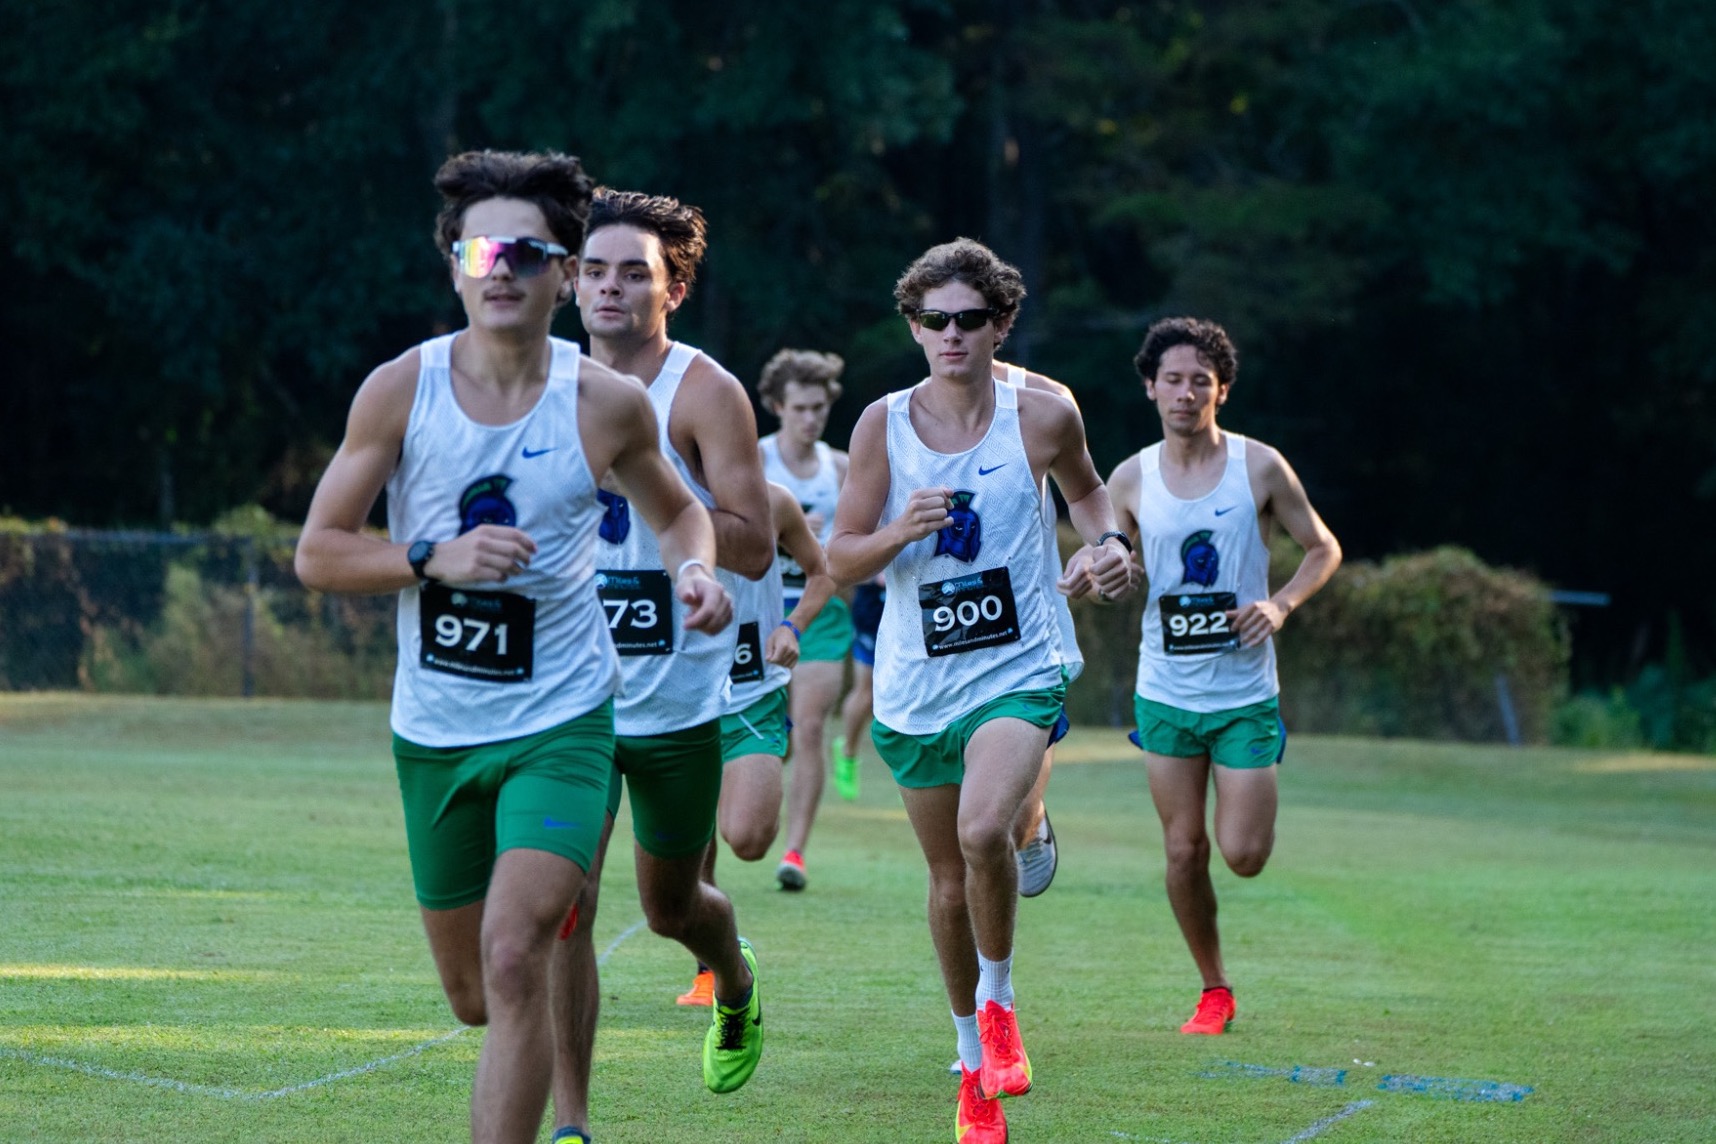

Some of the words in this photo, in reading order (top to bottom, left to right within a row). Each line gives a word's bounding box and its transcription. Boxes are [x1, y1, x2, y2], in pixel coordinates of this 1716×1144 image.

[602, 598, 658, 629] 73
[932, 594, 1003, 632] 900
[1168, 610, 1230, 637] 922
[435, 613, 508, 655] 971
[734, 643, 753, 665] 6
